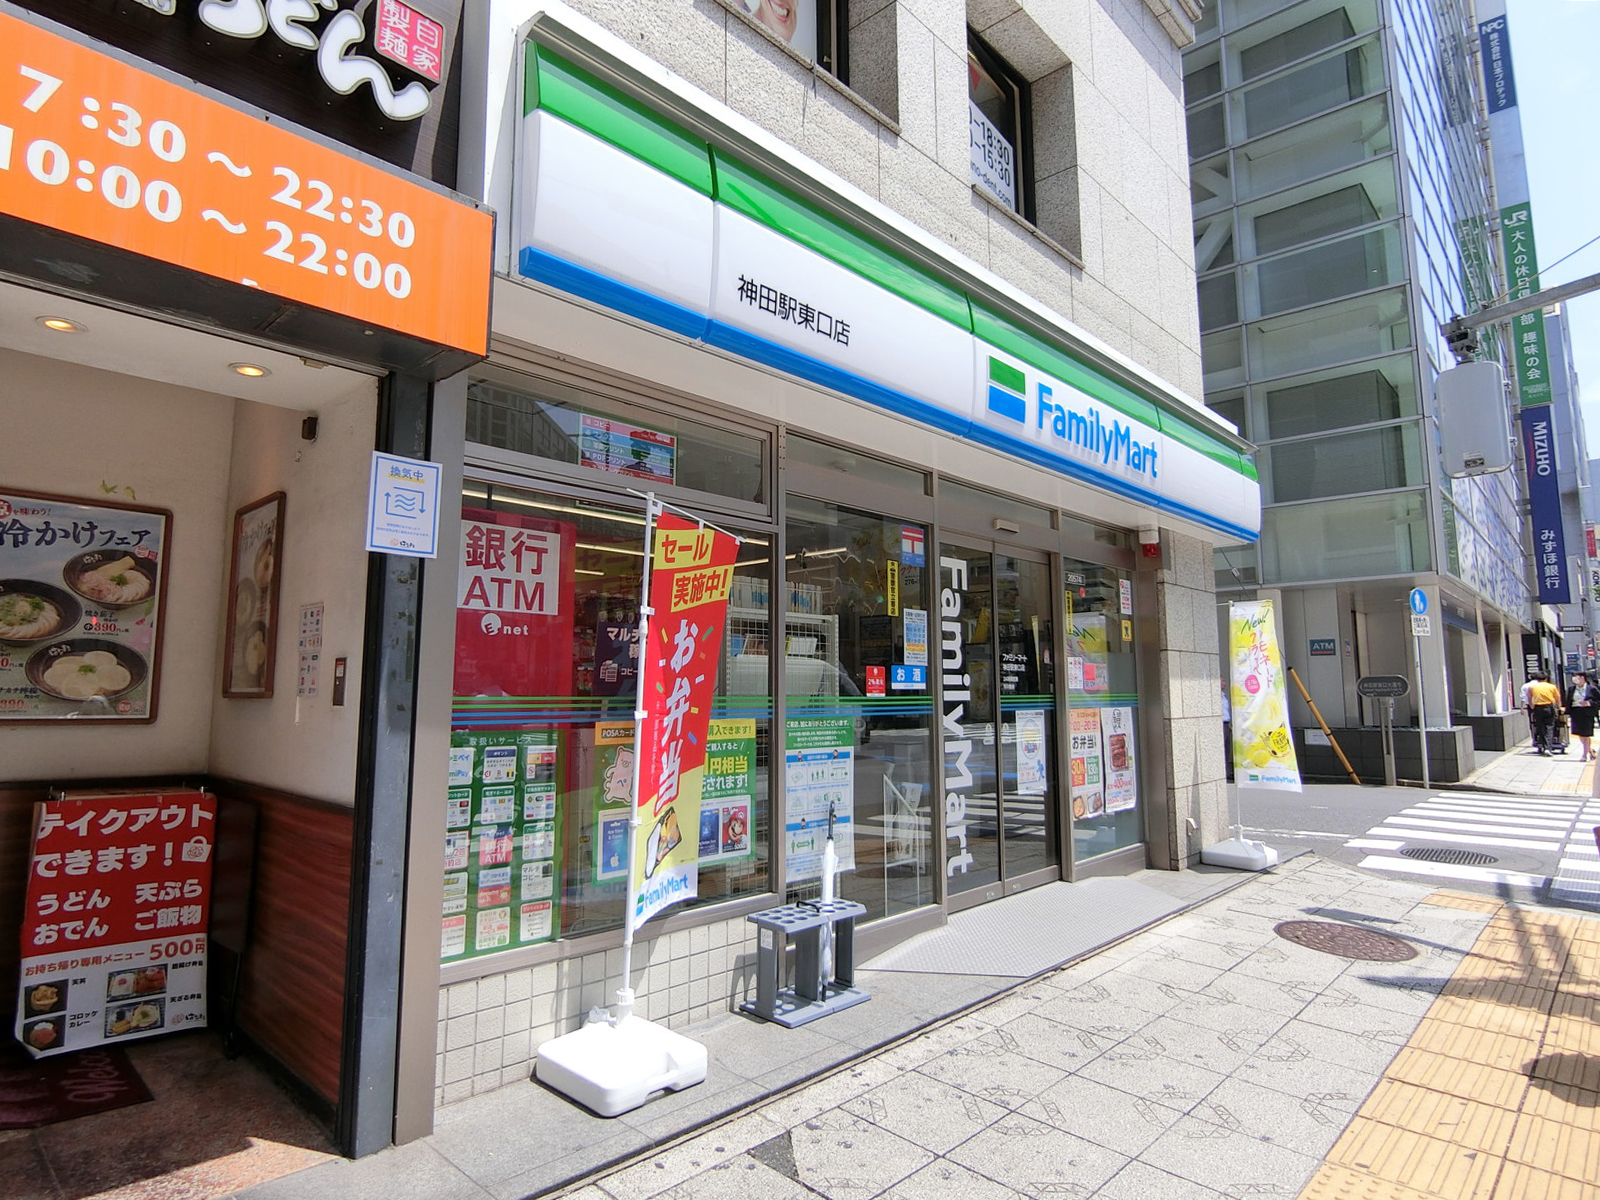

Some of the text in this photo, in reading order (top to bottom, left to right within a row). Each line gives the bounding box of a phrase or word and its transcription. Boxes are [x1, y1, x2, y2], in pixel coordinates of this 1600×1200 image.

[411, 19, 440, 77] 自家
[19, 65, 187, 163] 7:30
[270, 166, 415, 248] 22:30
[0, 124, 183, 223] 10:00
[263, 220, 412, 299] 22:00
[1503, 209, 1528, 227] JR
[735, 274, 851, 347] 神田駅東口店
[1036, 381, 1159, 479] FamilyMart
[1532, 420, 1551, 477] MIZUHO
[390, 465, 424, 481] 換気中
[464, 523, 549, 576] 銀行
[662, 533, 710, 564] セール
[1540, 529, 1560, 589] みずほ銀行
[462, 575, 545, 613] ATM
[1240, 608, 1270, 635] New!
[1312, 642, 1334, 650] ATM
[896, 667, 921, 682] お酒
[654, 619, 699, 814] お弁当
[939, 556, 974, 878] FamilyMart
[469, 736, 533, 746] 取扱いサービス
[1260, 774, 1297, 785] FamilyMart
[36, 803, 214, 840] テイクアウト
[484, 854, 506, 864] ATM
[36, 878, 203, 916] うどん 天ぷら
[643, 873, 689, 909] FamilyMart
[33, 905, 203, 946] おでん ご飯物
[24, 952, 146, 977] お持ち帰り専用メニュー
[68, 1019, 91, 1029] カレー
[69, 1009, 98, 1022] コロッケ
